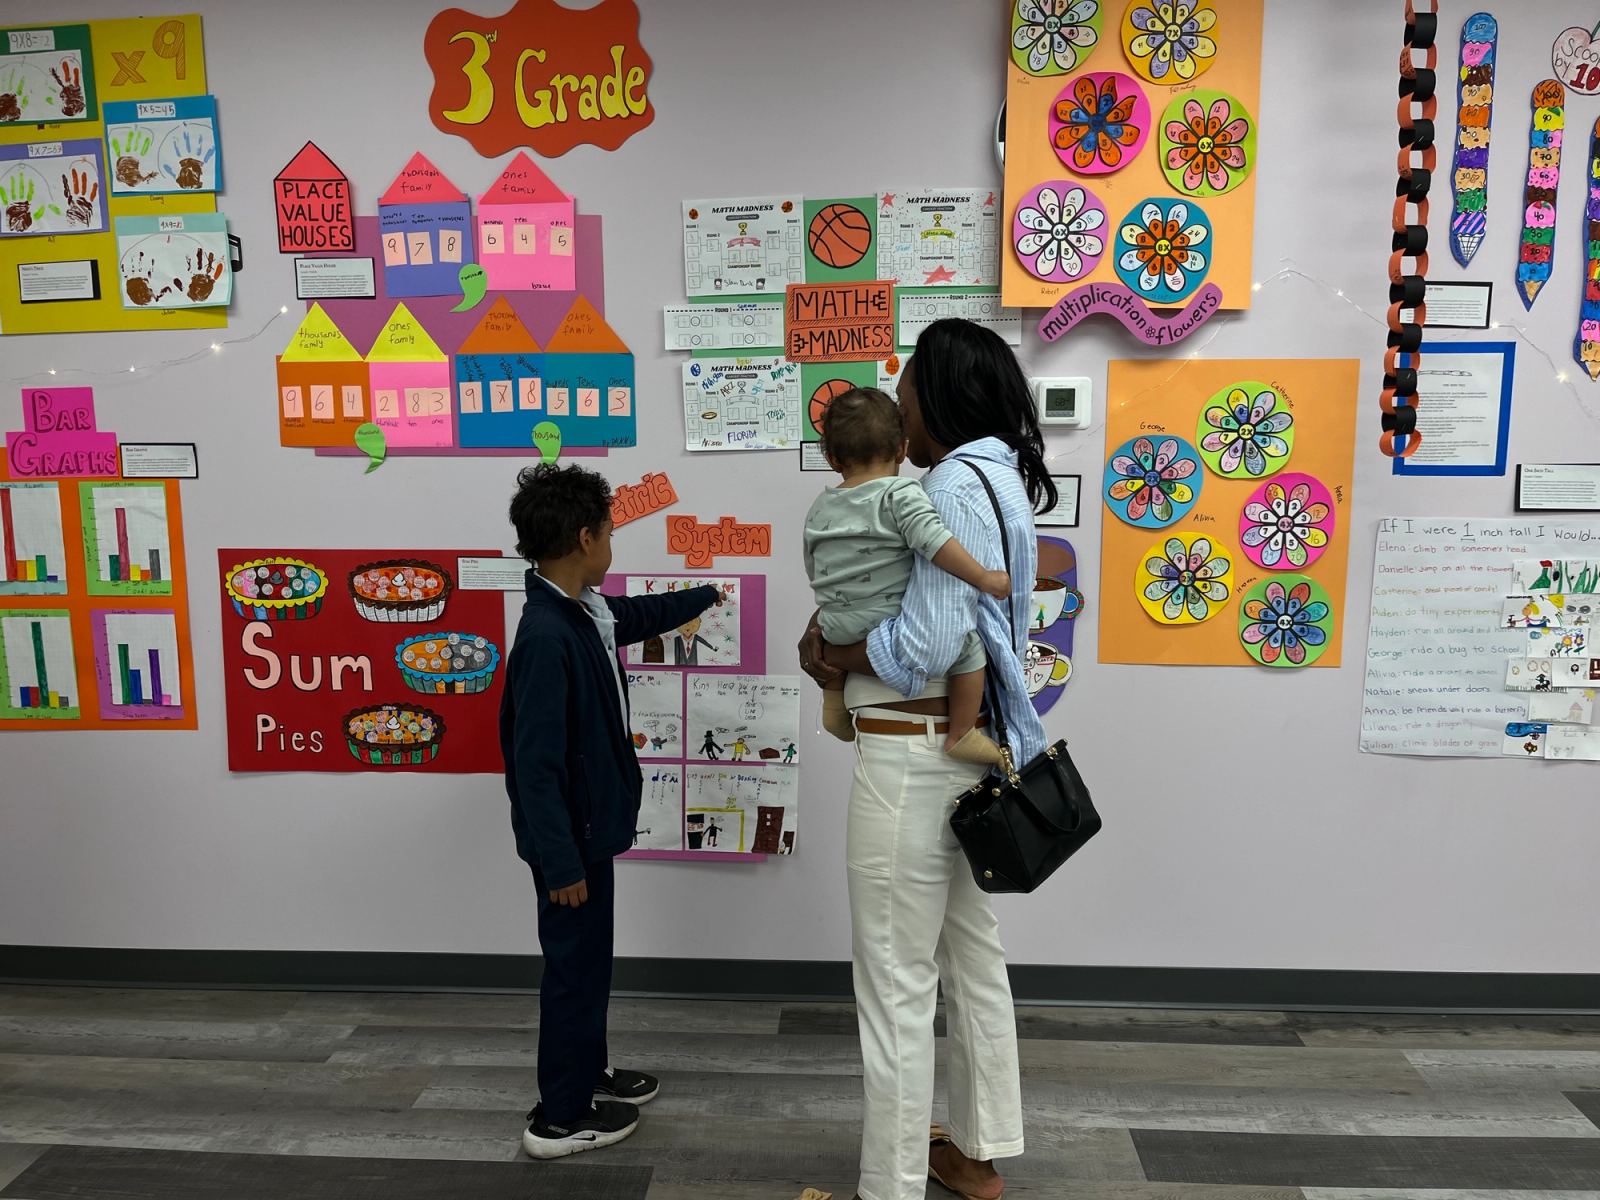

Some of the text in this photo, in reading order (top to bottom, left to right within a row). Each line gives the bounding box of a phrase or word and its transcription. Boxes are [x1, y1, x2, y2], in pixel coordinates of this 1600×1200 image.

[1047, 21, 1059, 29] 8X
[1166, 29, 1179, 38] 7X
[1555, 53, 1571, 78] by
[514, 45, 647, 129] Grade
[1542, 114, 1552, 123] 90
[1200, 141, 1213, 149] 6X
[1542, 135, 1553, 145] 80
[1539, 153, 1552, 162] 70
[282, 182, 345, 199] PLACE
[281, 203, 346, 223] VALUE
[711, 204, 775, 214] MATH MADNESS
[1050, 207, 1055, 216] 9
[1066, 208, 1072, 216] 2
[1533, 211, 1545, 221] 40
[1038, 219, 1043, 227] 8
[1076, 221, 1082, 229] 3
[281, 225, 352, 248] HOUSES
[1054, 228, 1068, 236] 6X
[487, 234, 567, 247] 6 4 5
[1038, 235, 1043, 243] 7
[1076, 236, 1082, 244] 4
[387, 236, 456, 257] 9 7 8
[1158, 243, 1170, 252] 8X
[1048, 248, 1054, 256] 6
[1064, 248, 1069, 256] 5
[1066, 262, 1077, 272] 30
[796, 289, 869, 319] MATH
[1042, 284, 1219, 345] multiplication flowers
[809, 325, 892, 356] MADNESS
[465, 388, 476, 410] 9
[527, 380, 536, 404] 8
[554, 391, 567, 410] 5
[584, 390, 593, 407] 6
[609, 390, 627, 411] 3
[285, 389, 444, 413] 9 6 4 2 8 3
[32, 390, 91, 434] BAR
[1240, 428, 1253, 436] 2X
[10, 432, 117, 477] GRAPHS
[609, 473, 673, 524] etric
[1275, 501, 1282, 509] 9
[1263, 512, 1269, 520] 8
[1301, 514, 1307, 522] 3
[1300, 528, 1306, 536] 4
[1380, 518, 1398, 533] If
[1403, 519, 1414, 534] I
[1424, 525, 1457, 535] were
[1480, 528, 1503, 537] inch
[1509, 526, 1531, 536] tall
[1535, 525, 1545, 538] I
[670, 517, 770, 567] System
[1273, 538, 1279, 546] 6
[1279, 618, 1293, 627] 4X
[241, 619, 374, 692] Sum
[1410, 644, 1485, 658] ride a bug to
[1401, 706, 1413, 715] be
[255, 713, 324, 754] Pies
